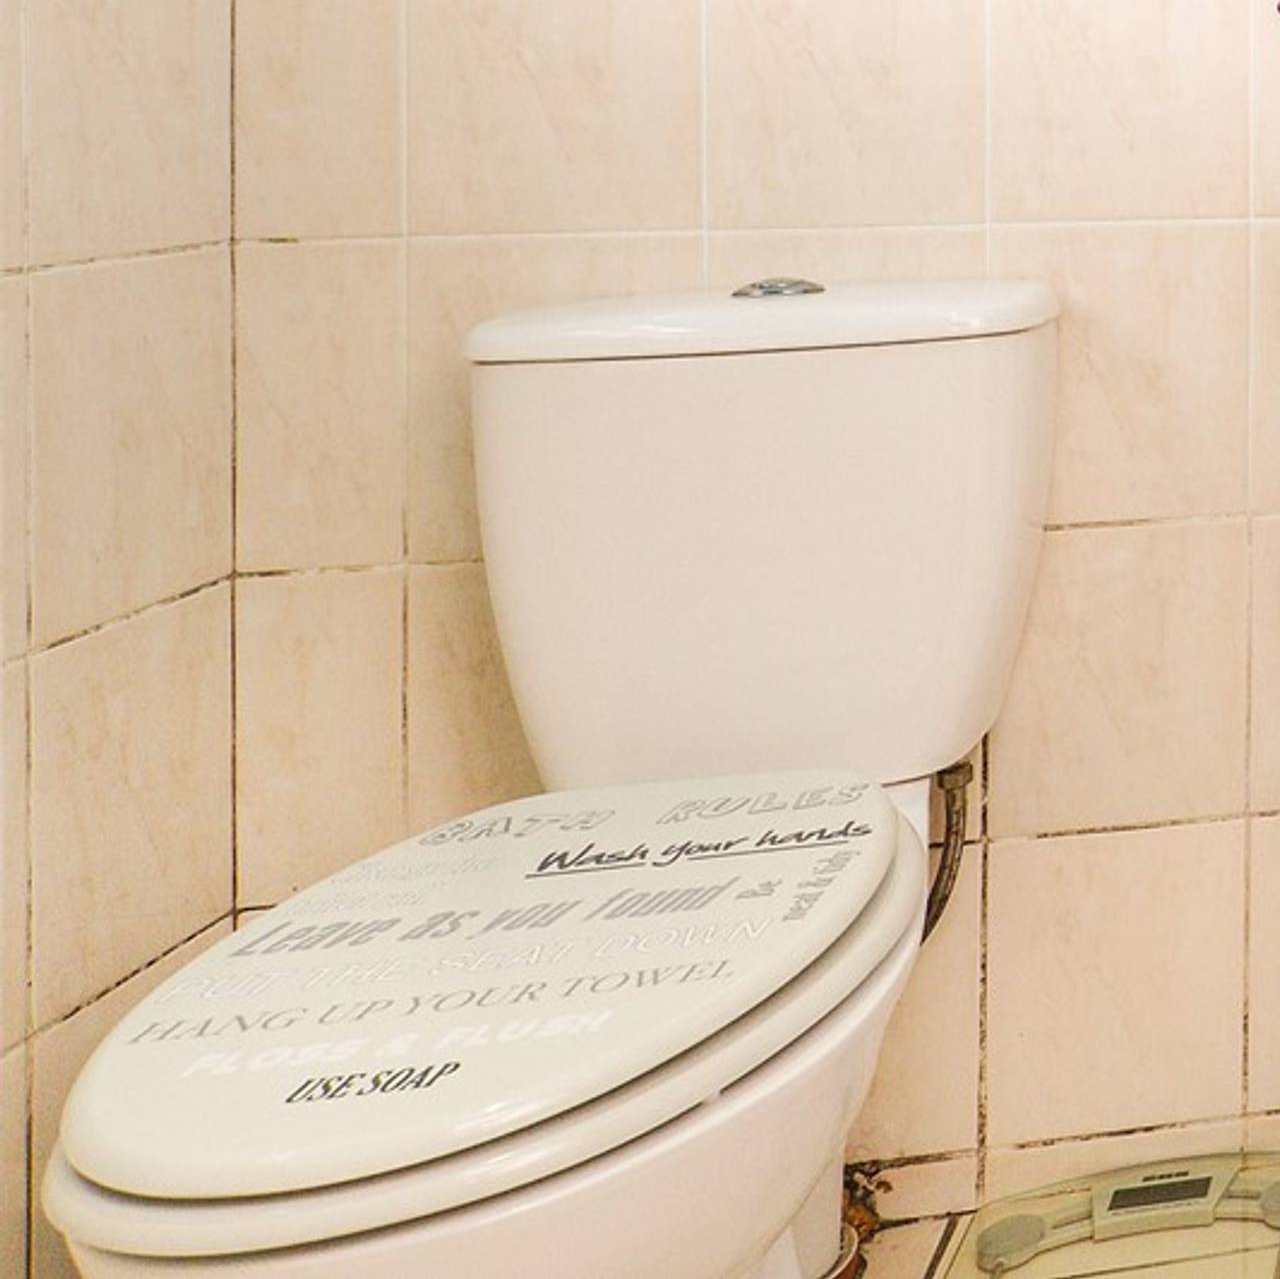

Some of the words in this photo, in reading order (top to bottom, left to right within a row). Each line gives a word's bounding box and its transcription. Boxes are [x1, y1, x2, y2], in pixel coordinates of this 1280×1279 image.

[419, 808, 616, 846] BATH
[655, 783, 870, 825] RULES
[535, 841, 651, 873] Wash
[652, 833, 750, 868] your
[755, 820, 873, 848] hands
[230, 917, 403, 957] Leave
[397, 909, 481, 942] as
[465, 898, 583, 940] you
[579, 875, 741, 921] found
[594, 918, 771, 957] DOWN
[124, 1006, 309, 1045] HANG
[317, 997, 396, 1025] UP
[404, 981, 548, 1016] YOUR
[562, 959, 736, 999] TOWEL
[284, 1071, 366, 1104] USE
[356, 1061, 462, 1096] SOAP
